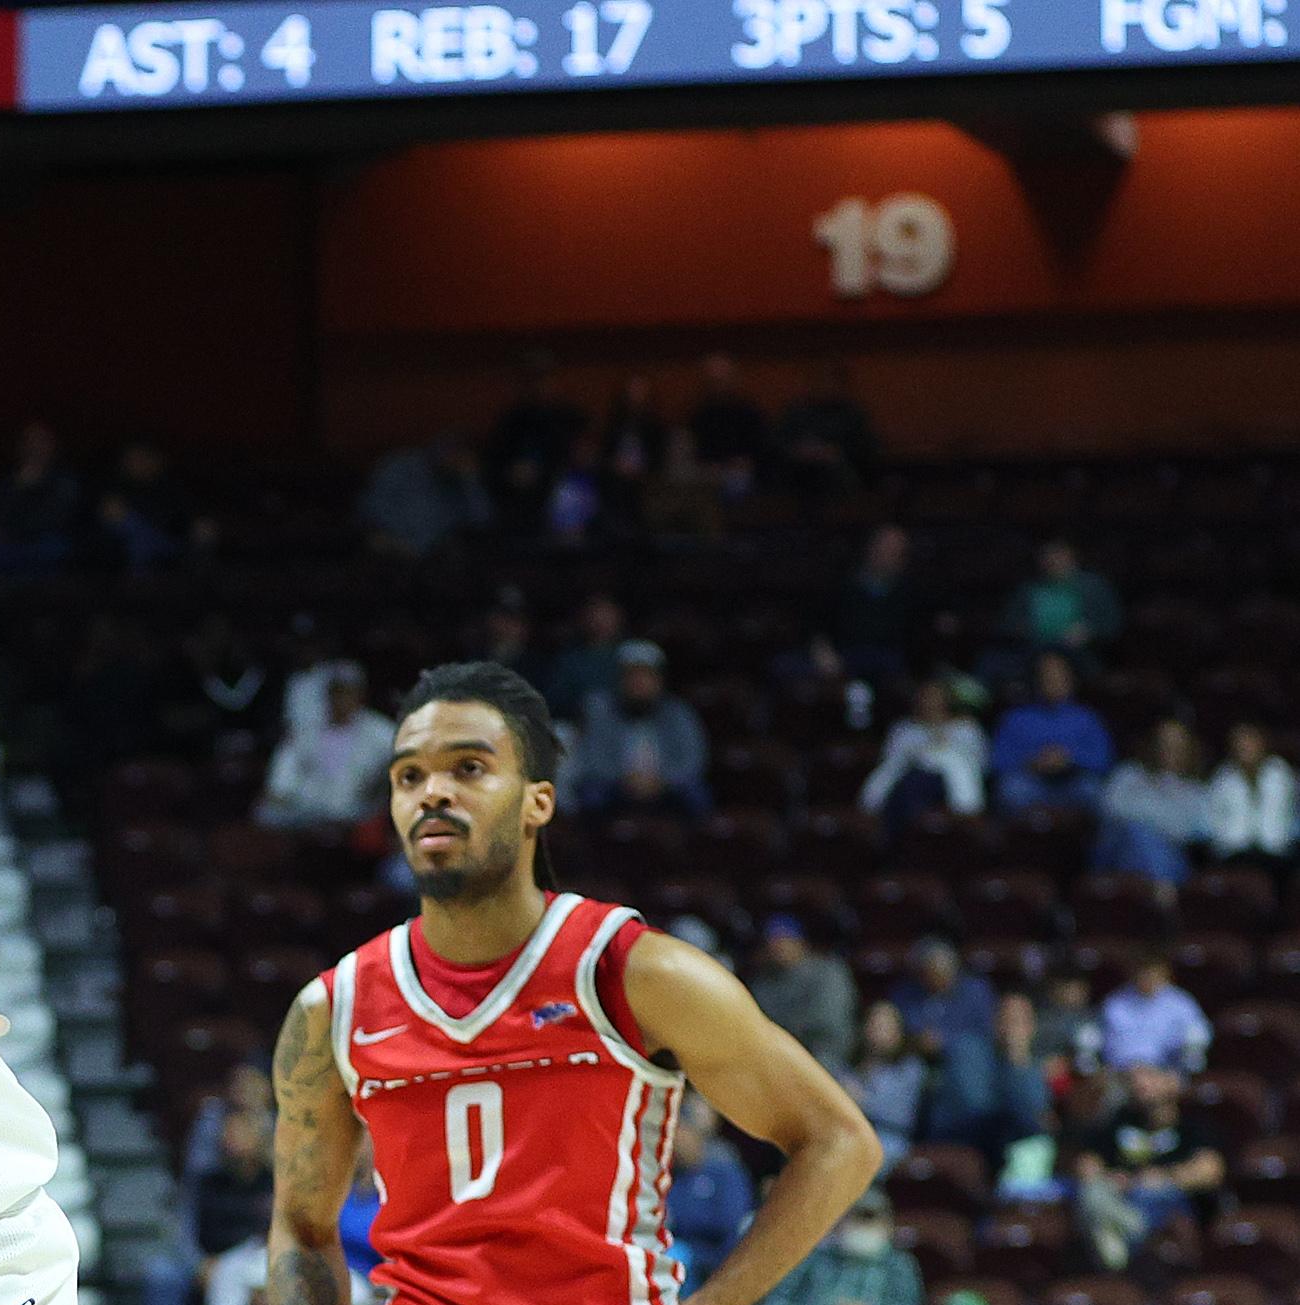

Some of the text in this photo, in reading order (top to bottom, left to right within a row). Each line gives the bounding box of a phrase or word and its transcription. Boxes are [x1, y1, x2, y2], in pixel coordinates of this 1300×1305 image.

[78, 0, 1288, 97] AST: 4 REB: 17 3PTS: 5 FGM:
[812, 191, 956, 298] 19
[445, 1081, 504, 1205] 0
